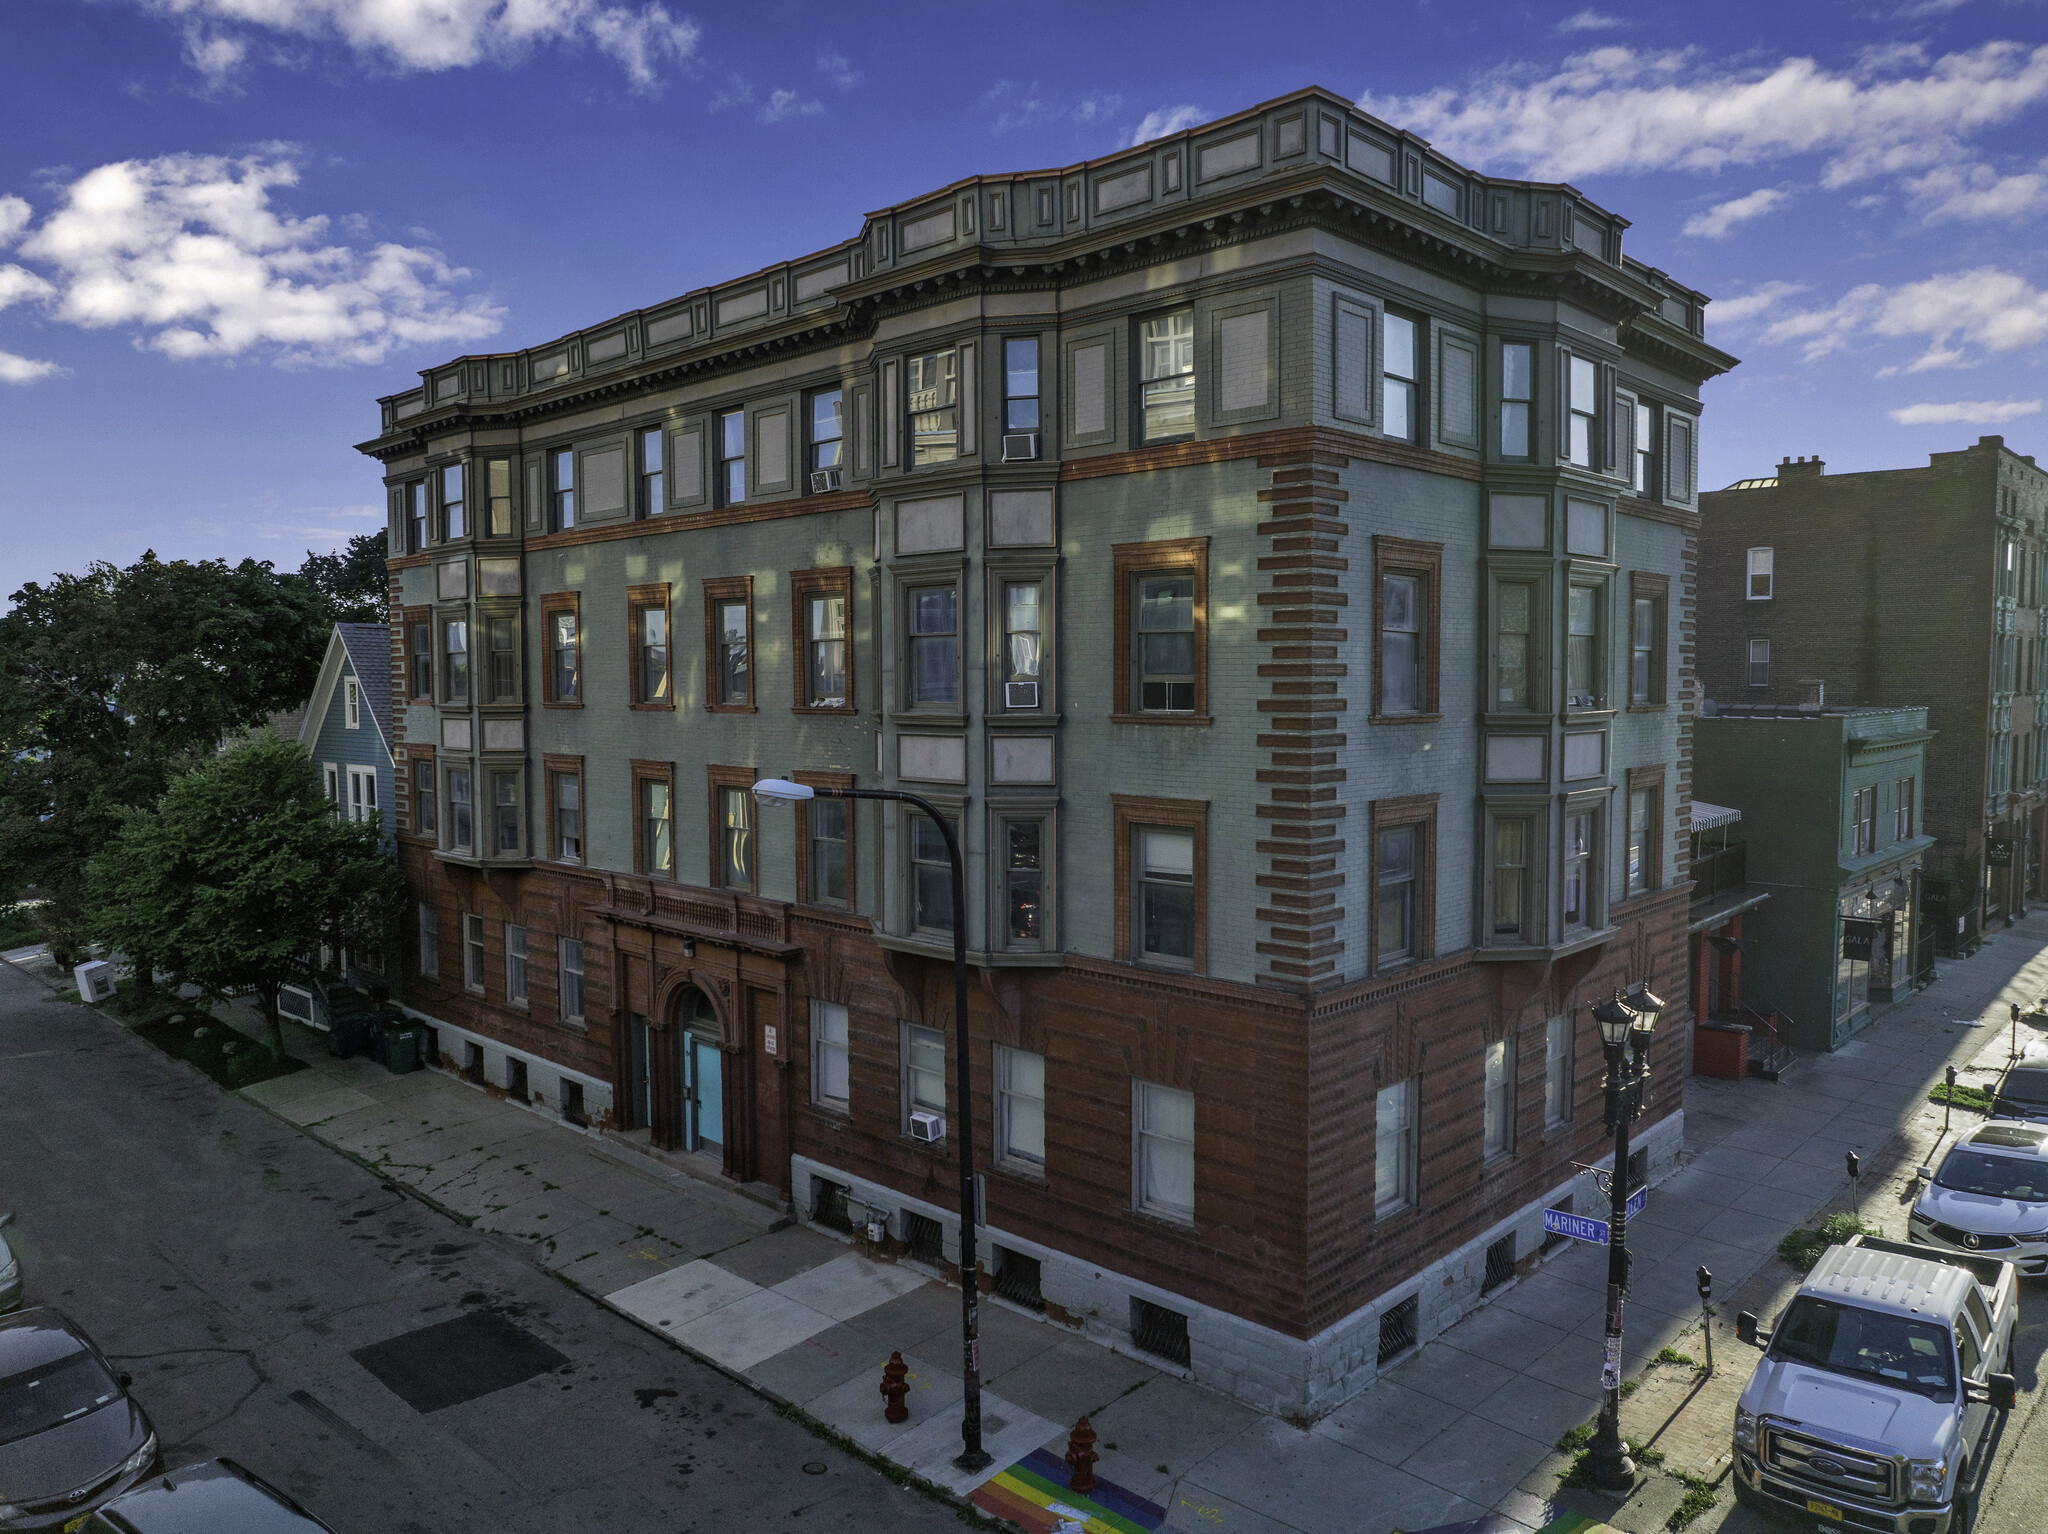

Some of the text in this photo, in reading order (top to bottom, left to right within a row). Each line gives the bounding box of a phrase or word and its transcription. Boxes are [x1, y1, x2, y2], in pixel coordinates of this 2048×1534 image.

[1925, 893, 1947, 902] GALA
[1845, 935, 1870, 945] GALA
[1626, 1193, 1642, 1218] LLEN
[1544, 1212, 1595, 1238] MARINER
